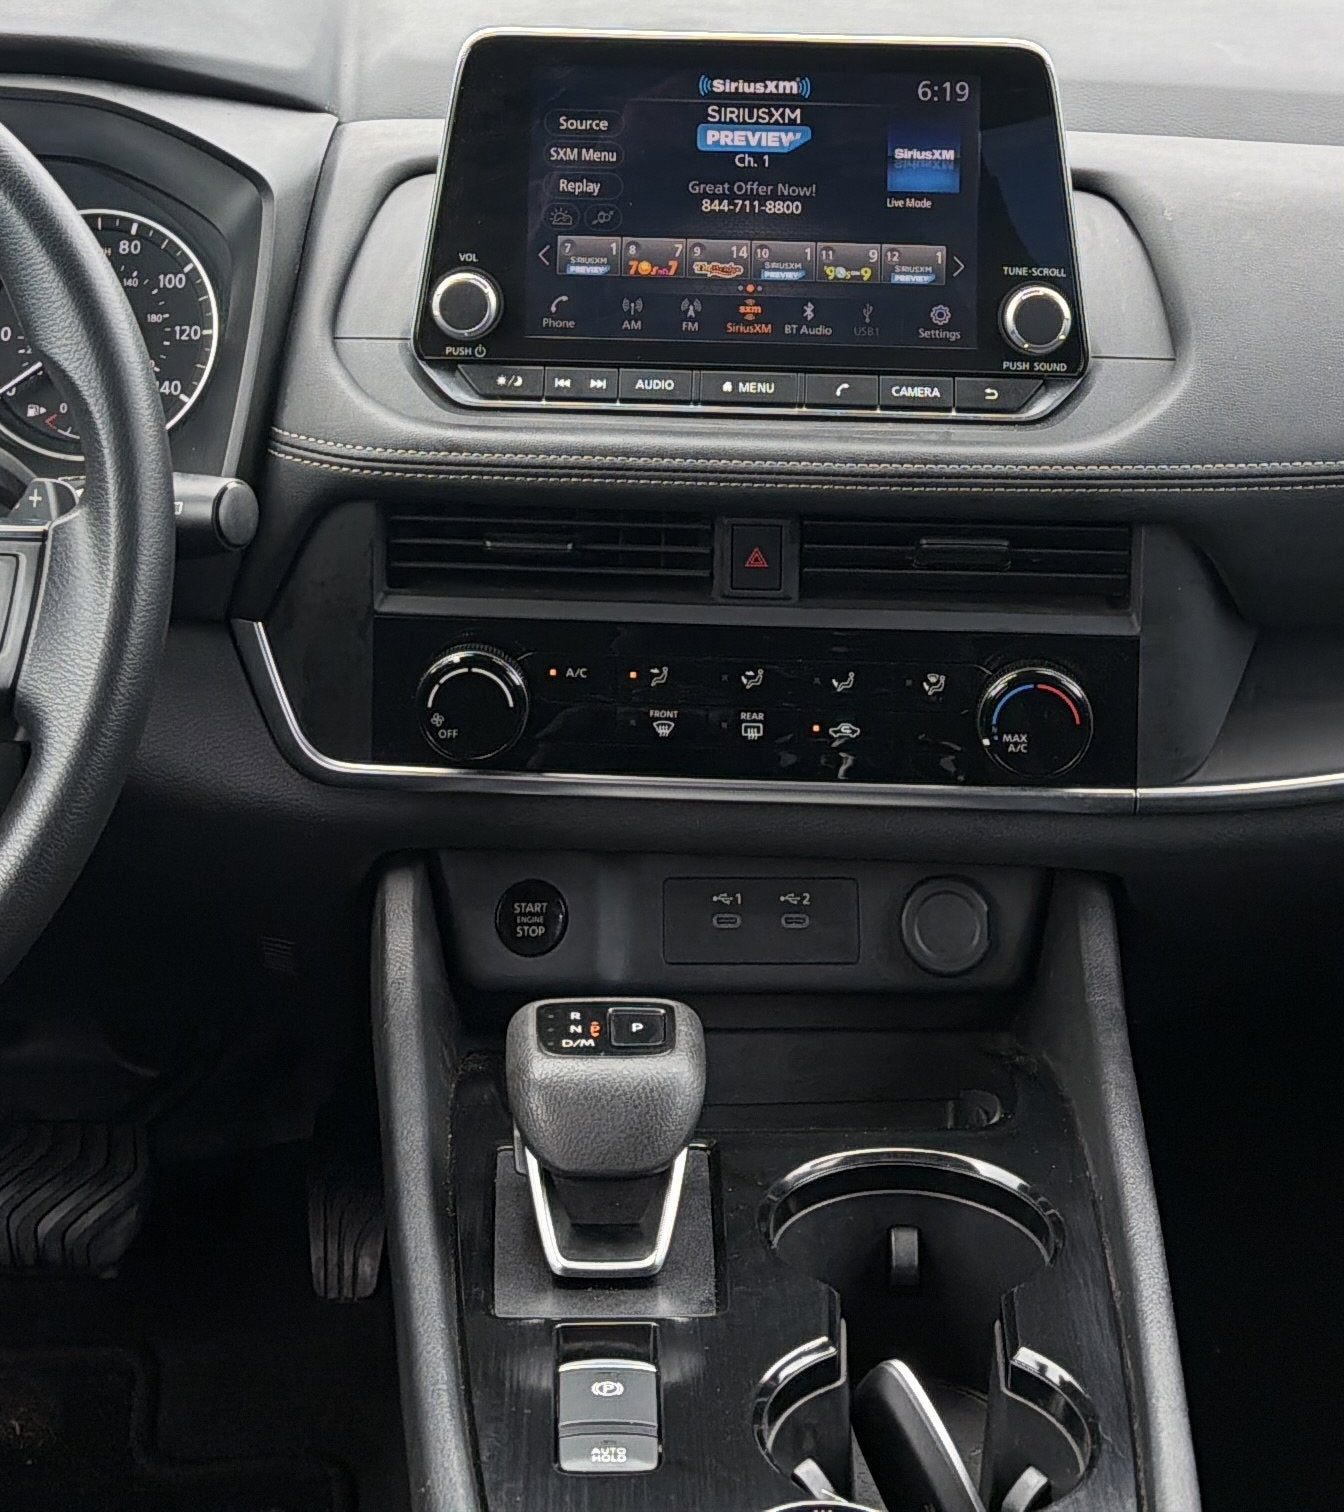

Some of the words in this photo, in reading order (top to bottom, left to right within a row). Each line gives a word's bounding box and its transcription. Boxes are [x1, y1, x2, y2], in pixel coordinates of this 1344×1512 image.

[917, 80, 970, 102] 6:19
[707, 106, 801, 124] SIRIUSXM
[559, 116, 609, 130] Source
[706, 130, 802, 148] PREVIEW
[550, 147, 579, 161] SXM
[581, 148, 617, 162] Menu
[894, 148, 955, 161] SiriusXM
[735, 154, 758, 168] Ch.
[763, 155, 770, 168] 1
[559, 179, 601, 196] Replay
[688, 180, 730, 195] Great
[733, 181, 773, 196] Offer
[777, 183, 817, 197] Now!
[701, 199, 802, 214] 844-711-8800
[887, 197, 905, 208] Live
[119, 240, 142, 255] 80
[674, 245, 684, 257] 7
[731, 246, 748, 259] 14
[756, 248, 770, 259] 10
[459, 253, 479, 263] VOL
[821, 250, 833, 261] 11
[868, 249, 879, 262] 9
[886, 251, 900, 262] 12
[123, 277, 139, 288] 140
[158, 273, 186, 289] 100
[147, 313, 163, 324] 180
[542, 317, 577, 330] Phone
[622, 319, 643, 331] AM
[682, 321, 700, 332] FM
[726, 322, 773, 335] SiriusXM
[784, 324, 799, 335] BT
[800, 324, 833, 336] Audio
[174, 325, 202, 341] 120
[853, 326, 880, 337] USB1
[918, 327, 962, 342] Settings
[445, 346, 472, 357] PUSH
[1002, 360, 1031, 372] PUSH
[1034, 362, 1068, 373] SOUND
[634, 378, 675, 391] AUDIO
[738, 380, 775, 394] MENU
[891, 385, 941, 399] CAMERA
[565, 666, 588, 678] A/C
[649, 709, 678, 719] FRONT
[740, 712, 765, 721] REAR
[437, 728, 460, 740] OFF
[1002, 733, 1028, 744] MAX
[1007, 743, 1028, 754] A/C
[735, 893, 743, 905] 1
[802, 893, 811, 906] 2
[513, 902, 548, 914] START
[516, 916, 544, 924] ENGINE
[516, 925, 546, 937] STOP
[570, 1011, 581, 1021] R
[569, 1025, 583, 1034] N
[631, 1022, 644, 1033] P
[561, 1038, 596, 1048] D/M
[590, 1446, 628, 1455] AUTO
[591, 1454, 628, 1464] HOLD
